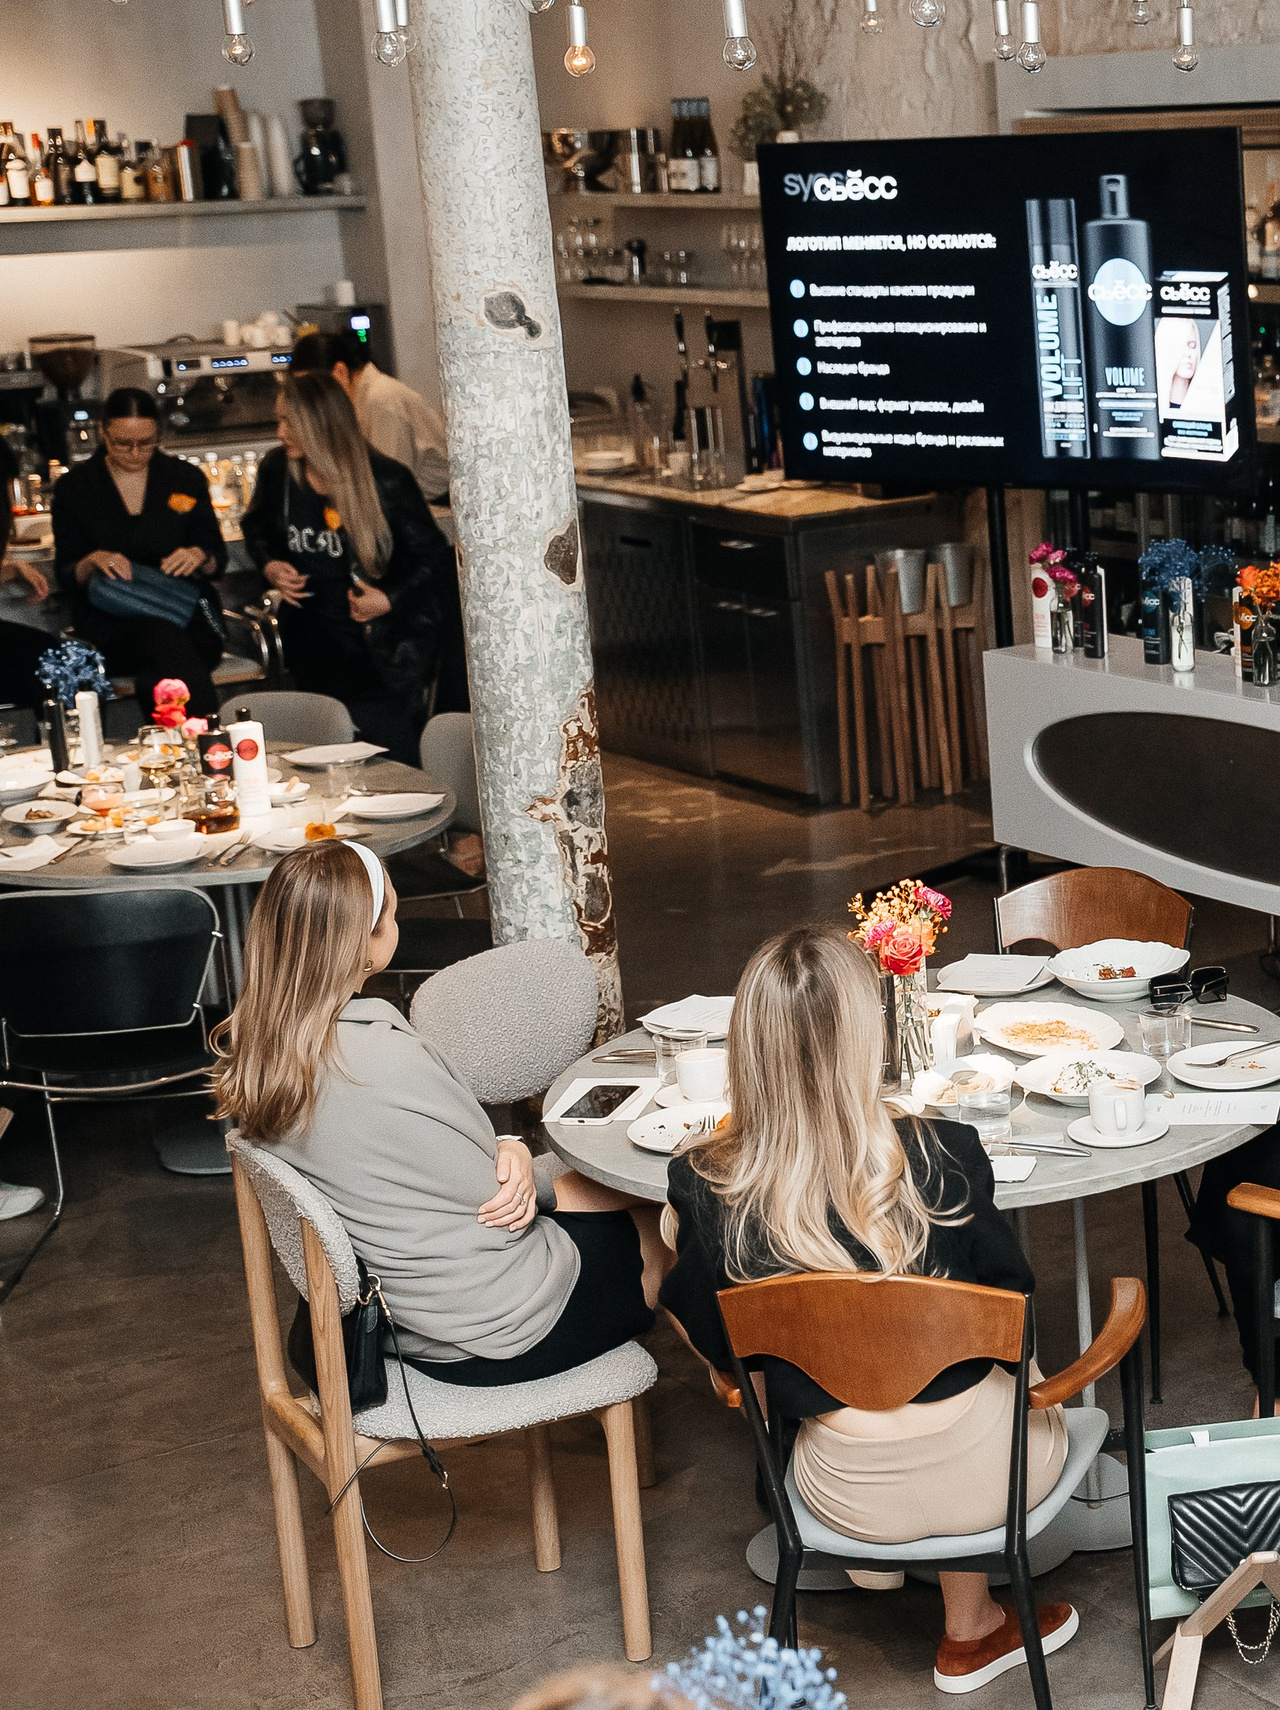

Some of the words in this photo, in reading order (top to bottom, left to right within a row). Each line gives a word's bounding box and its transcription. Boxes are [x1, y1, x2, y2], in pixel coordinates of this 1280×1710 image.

[1035, 293, 1064, 400] VOLUME
[1061, 353, 1084, 400] LIFT
[1105, 367, 1145, 386] VOLUME
